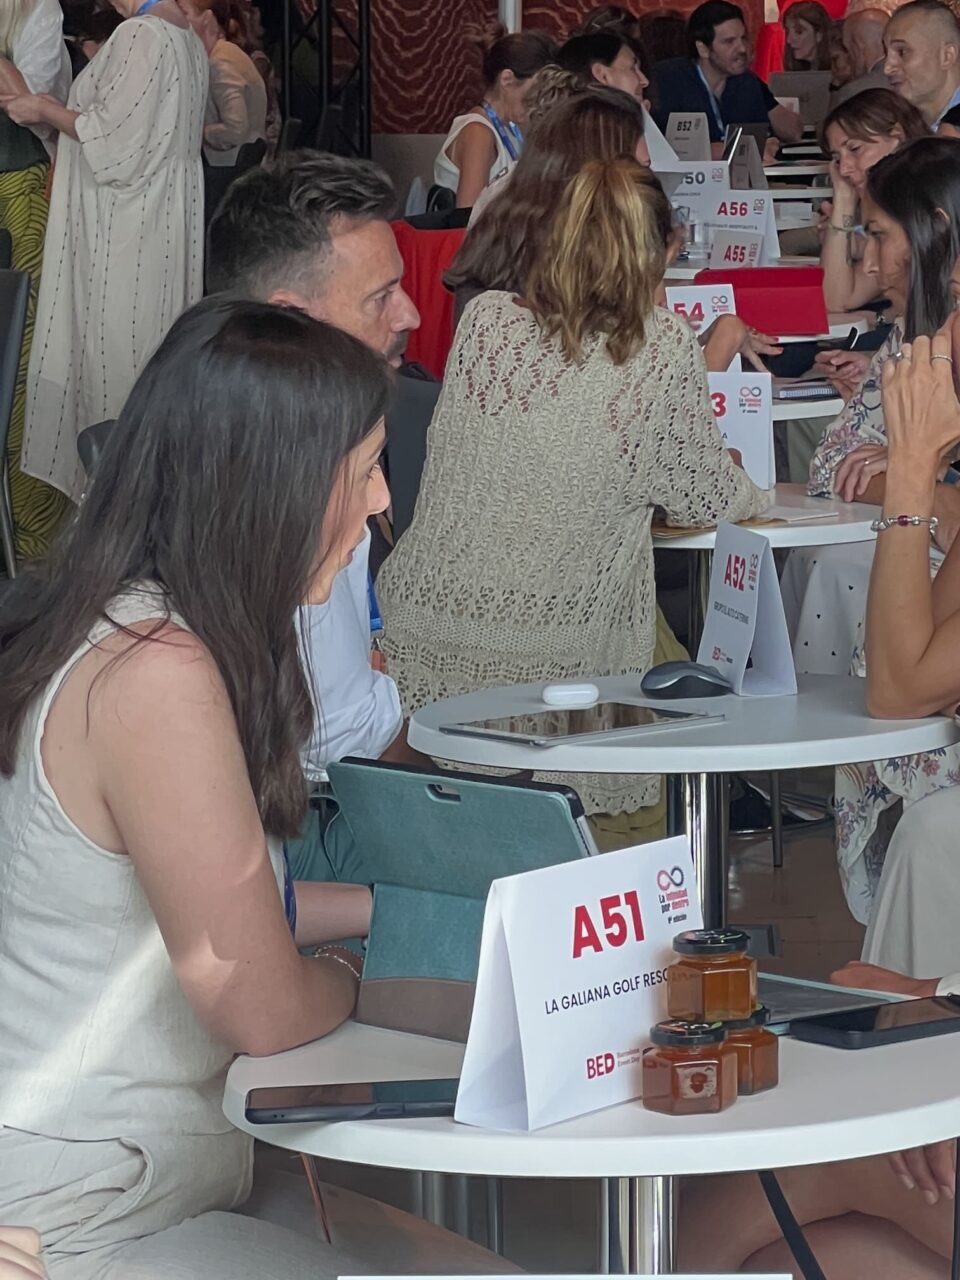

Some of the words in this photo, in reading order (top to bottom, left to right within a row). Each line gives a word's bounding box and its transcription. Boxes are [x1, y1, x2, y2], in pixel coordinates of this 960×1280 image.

[676, 120, 692, 132] B52
[680, 171, 706, 185] 50
[717, 201, 748, 217] A56
[723, 244, 747, 263] A55
[723, 553, 746, 592] A52
[572, 890, 645, 959] A51
[545, 999, 559, 1015] LA
[561, 985, 611, 1010] GALIANA
[613, 975, 640, 996] GOLF
[586, 1052, 615, 1080] BED
